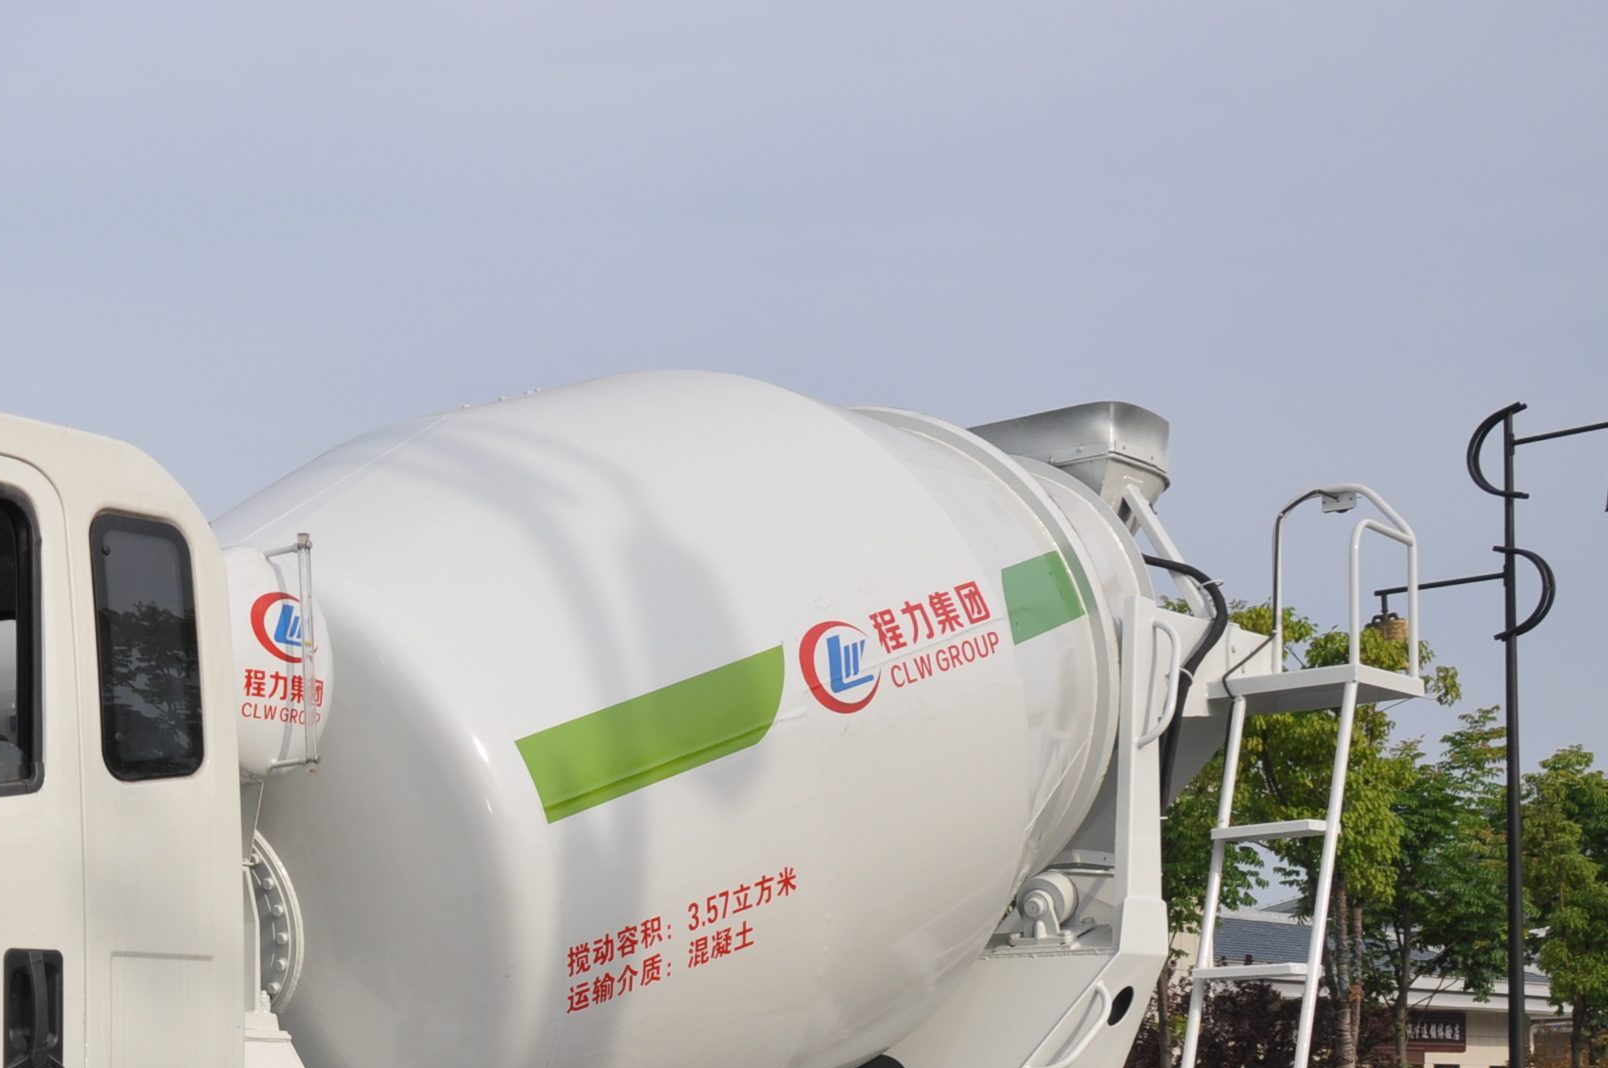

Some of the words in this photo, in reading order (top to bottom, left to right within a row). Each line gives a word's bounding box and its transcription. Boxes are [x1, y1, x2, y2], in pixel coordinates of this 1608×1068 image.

[869, 580, 991, 654] 程力集团
[890, 653, 933, 688] CLW
[935, 631, 1000, 672] GROUP
[241, 702, 277, 720] CLW
